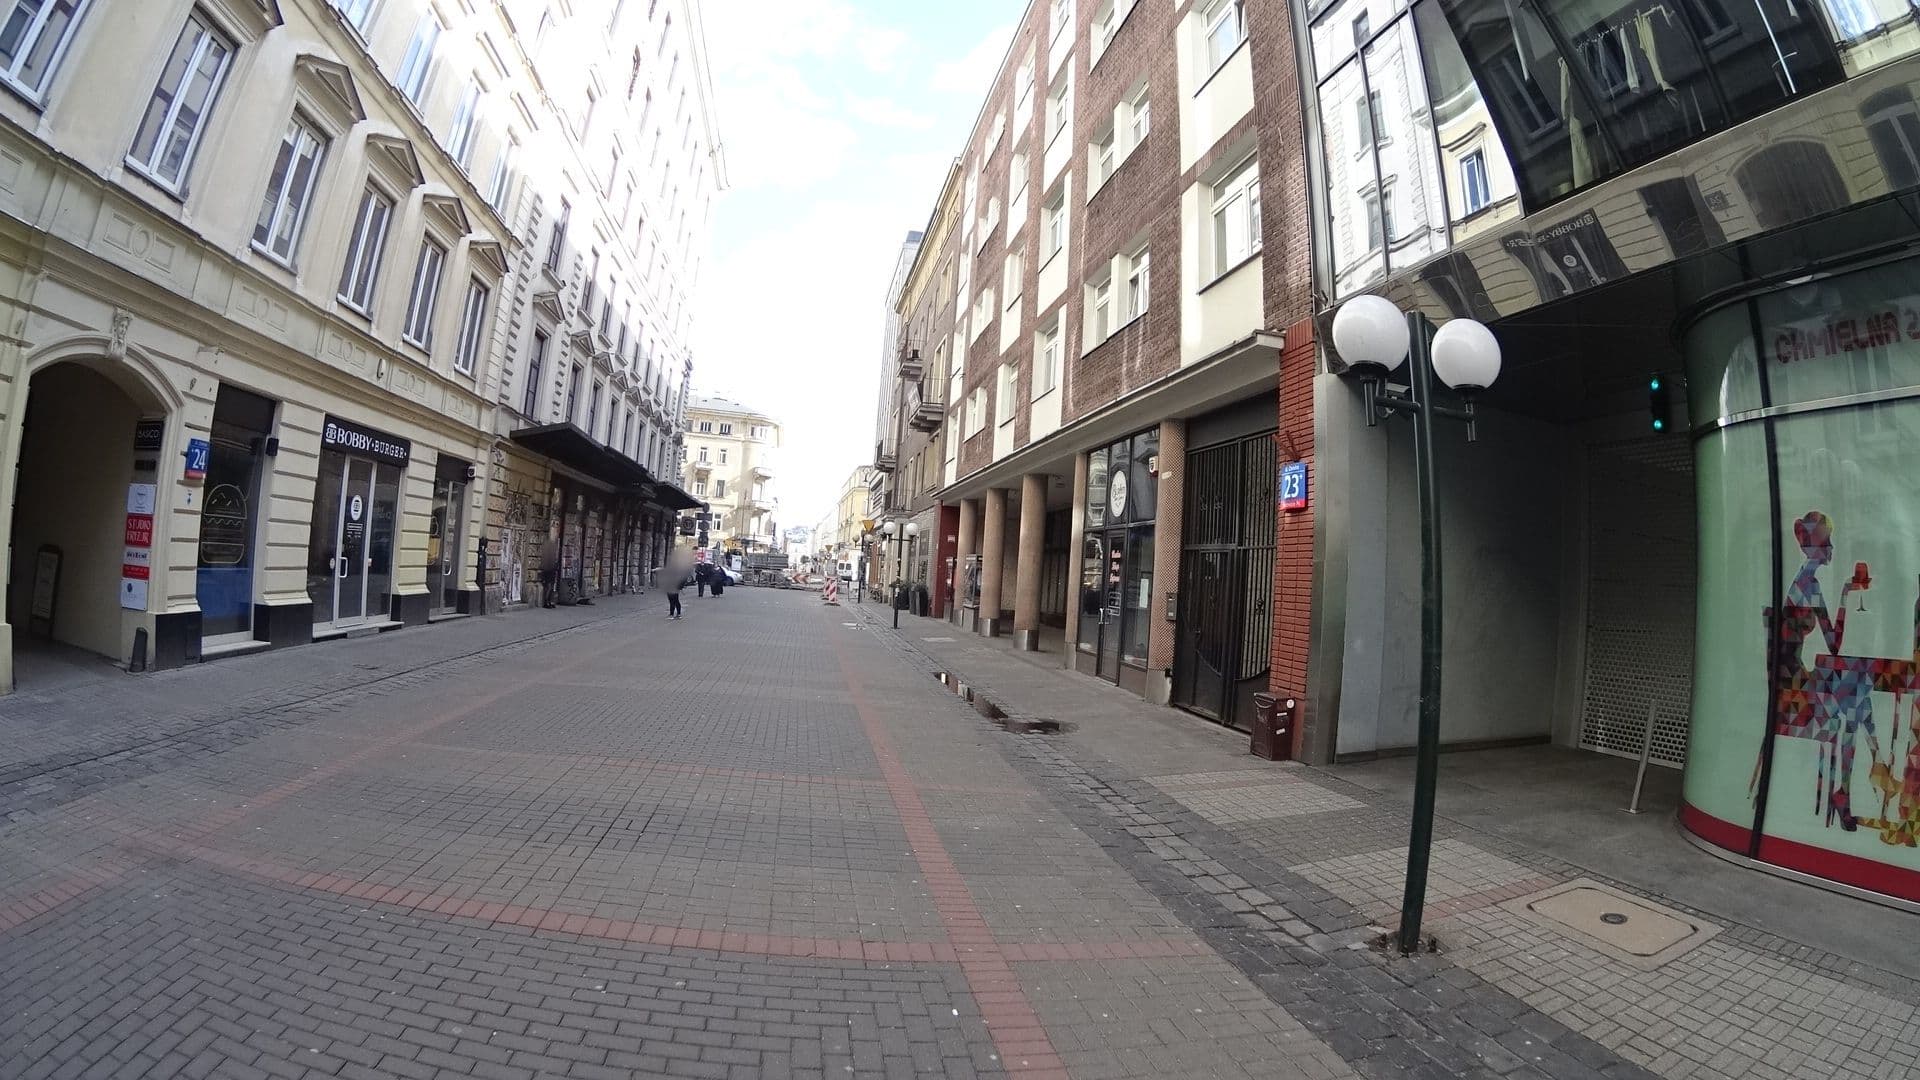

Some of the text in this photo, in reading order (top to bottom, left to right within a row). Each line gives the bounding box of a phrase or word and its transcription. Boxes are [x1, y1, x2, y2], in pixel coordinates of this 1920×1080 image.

[1774, 311, 1901, 364] CHMIELNA
[337, 428, 372, 451] BOBBY
[374, 440, 405, 459] BURGER
[192, 449, 206, 470] 24
[1284, 474, 1300, 499] 23
[128, 518, 151, 530] STUDIO
